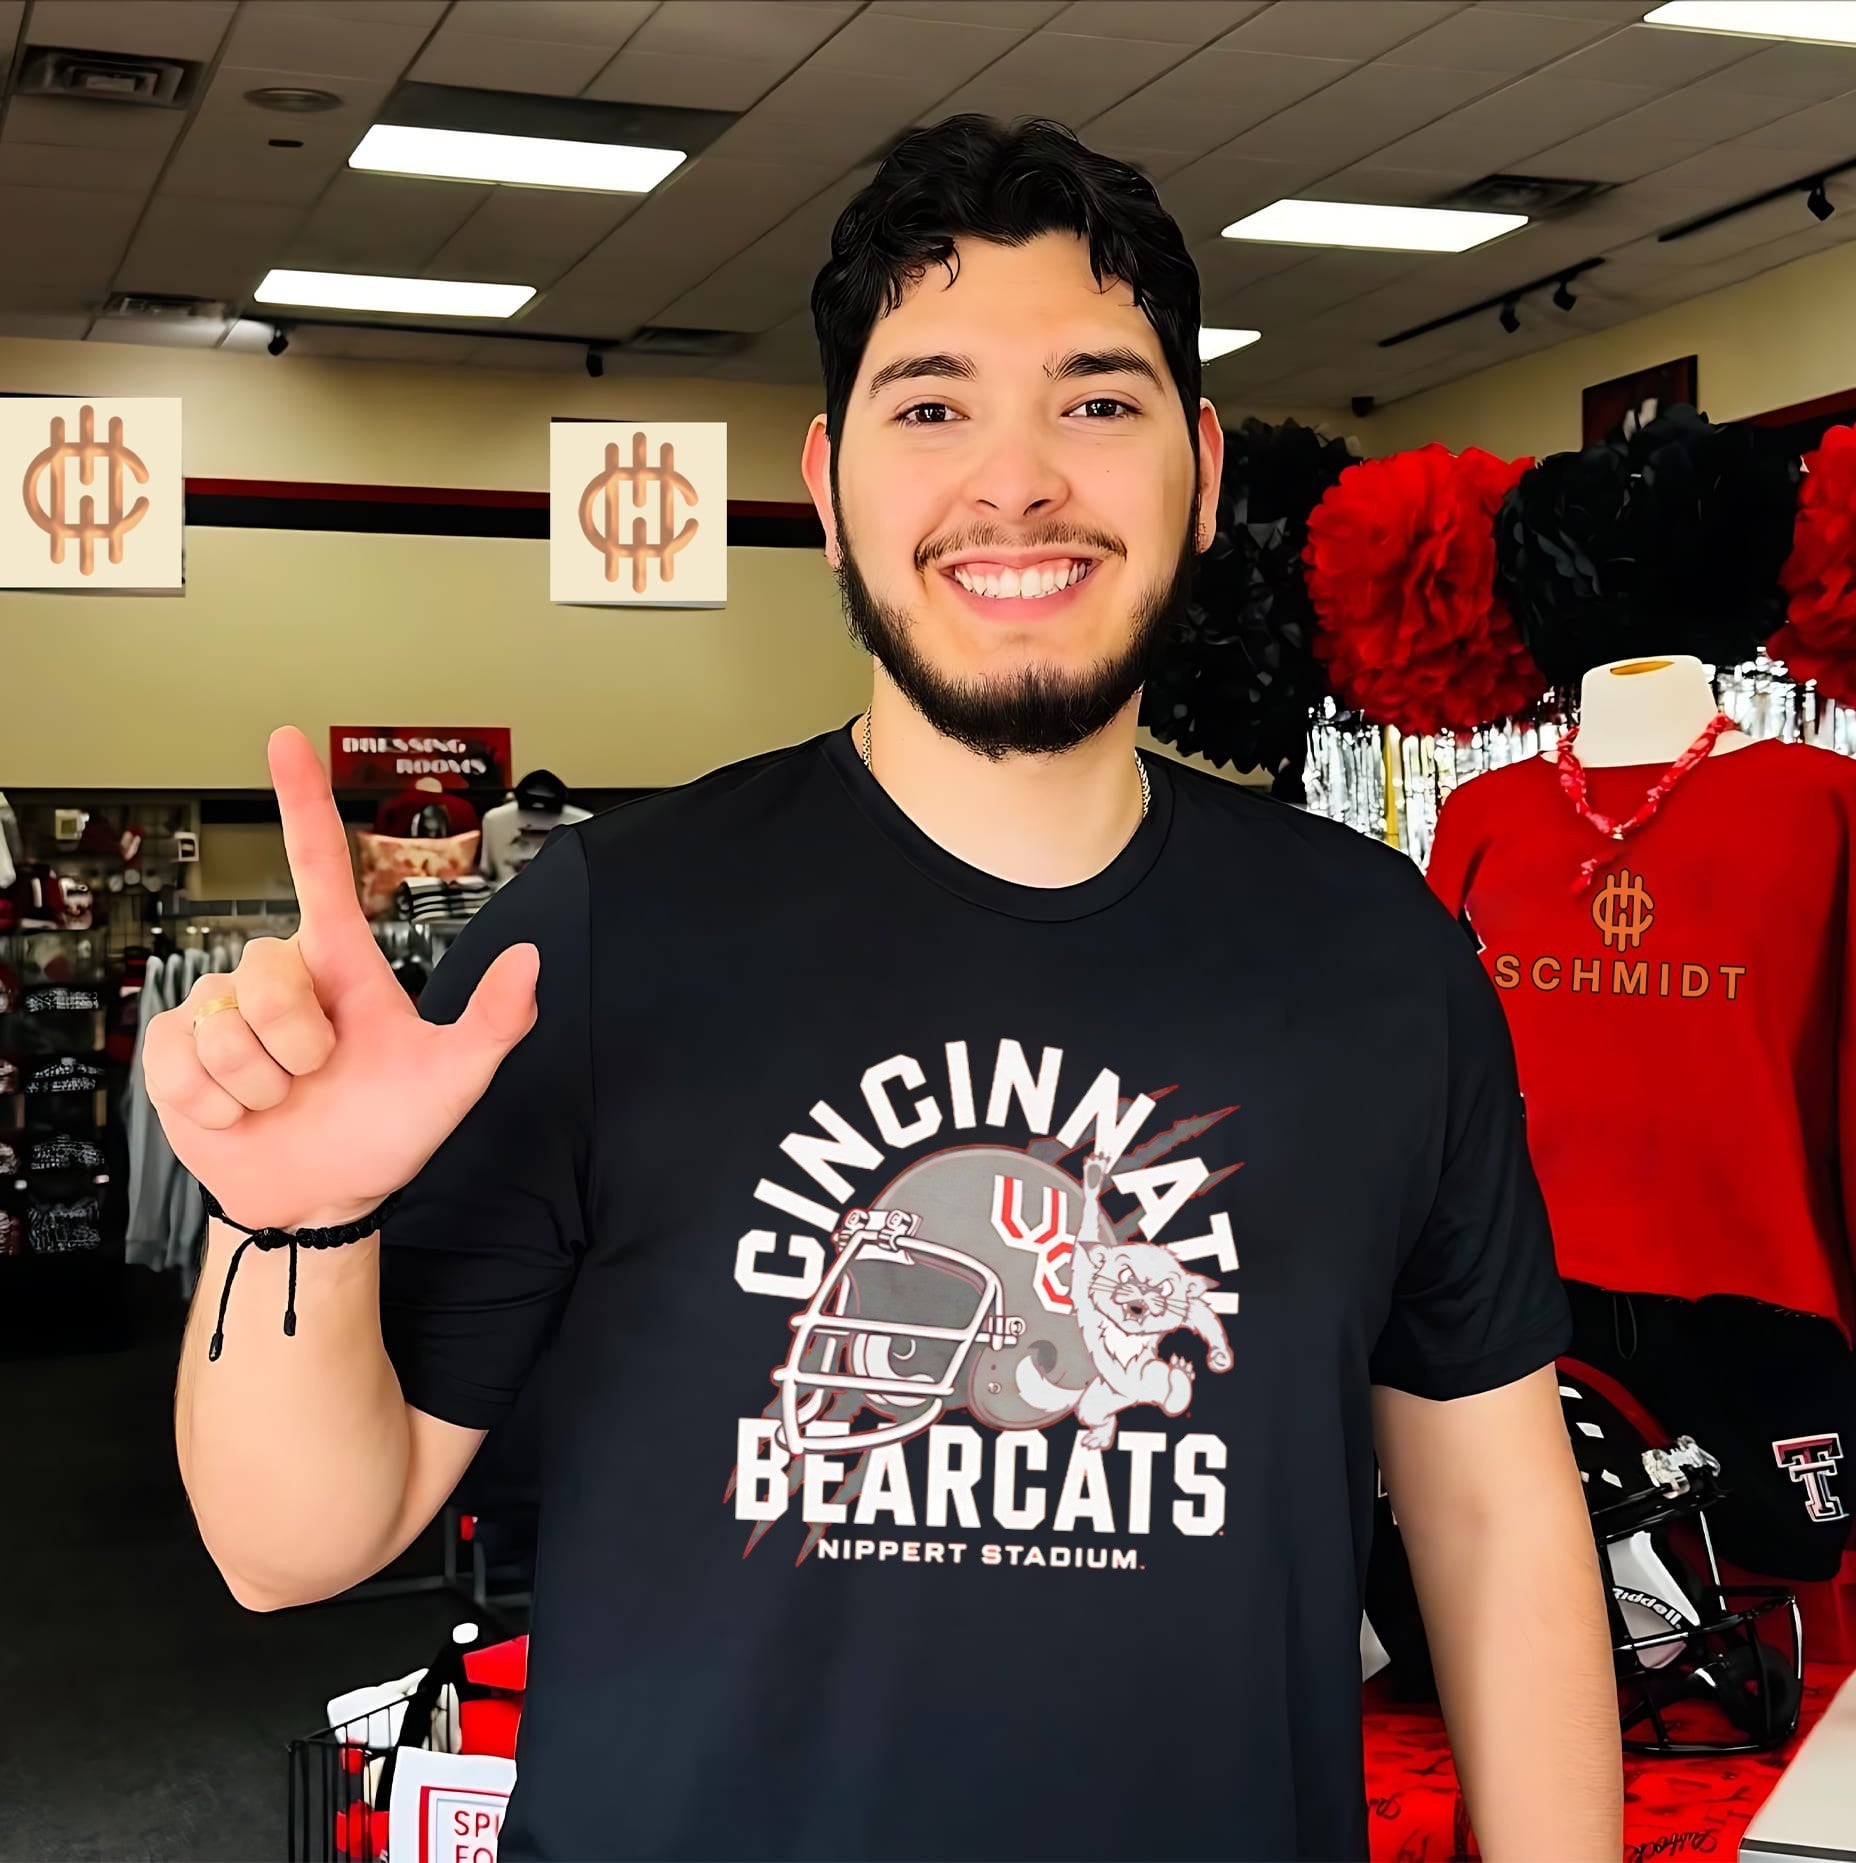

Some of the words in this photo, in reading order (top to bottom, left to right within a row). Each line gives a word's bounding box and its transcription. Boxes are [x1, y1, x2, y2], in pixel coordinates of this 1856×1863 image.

[342, 736, 467, 754] DRESSING
[396, 758, 488, 775] ROOMS
[1494, 953, 1746, 1000] SCHMIDT
[735, 1417, 1228, 1537] BEARCATS
[818, 1539, 967, 1564] NIPPERT
